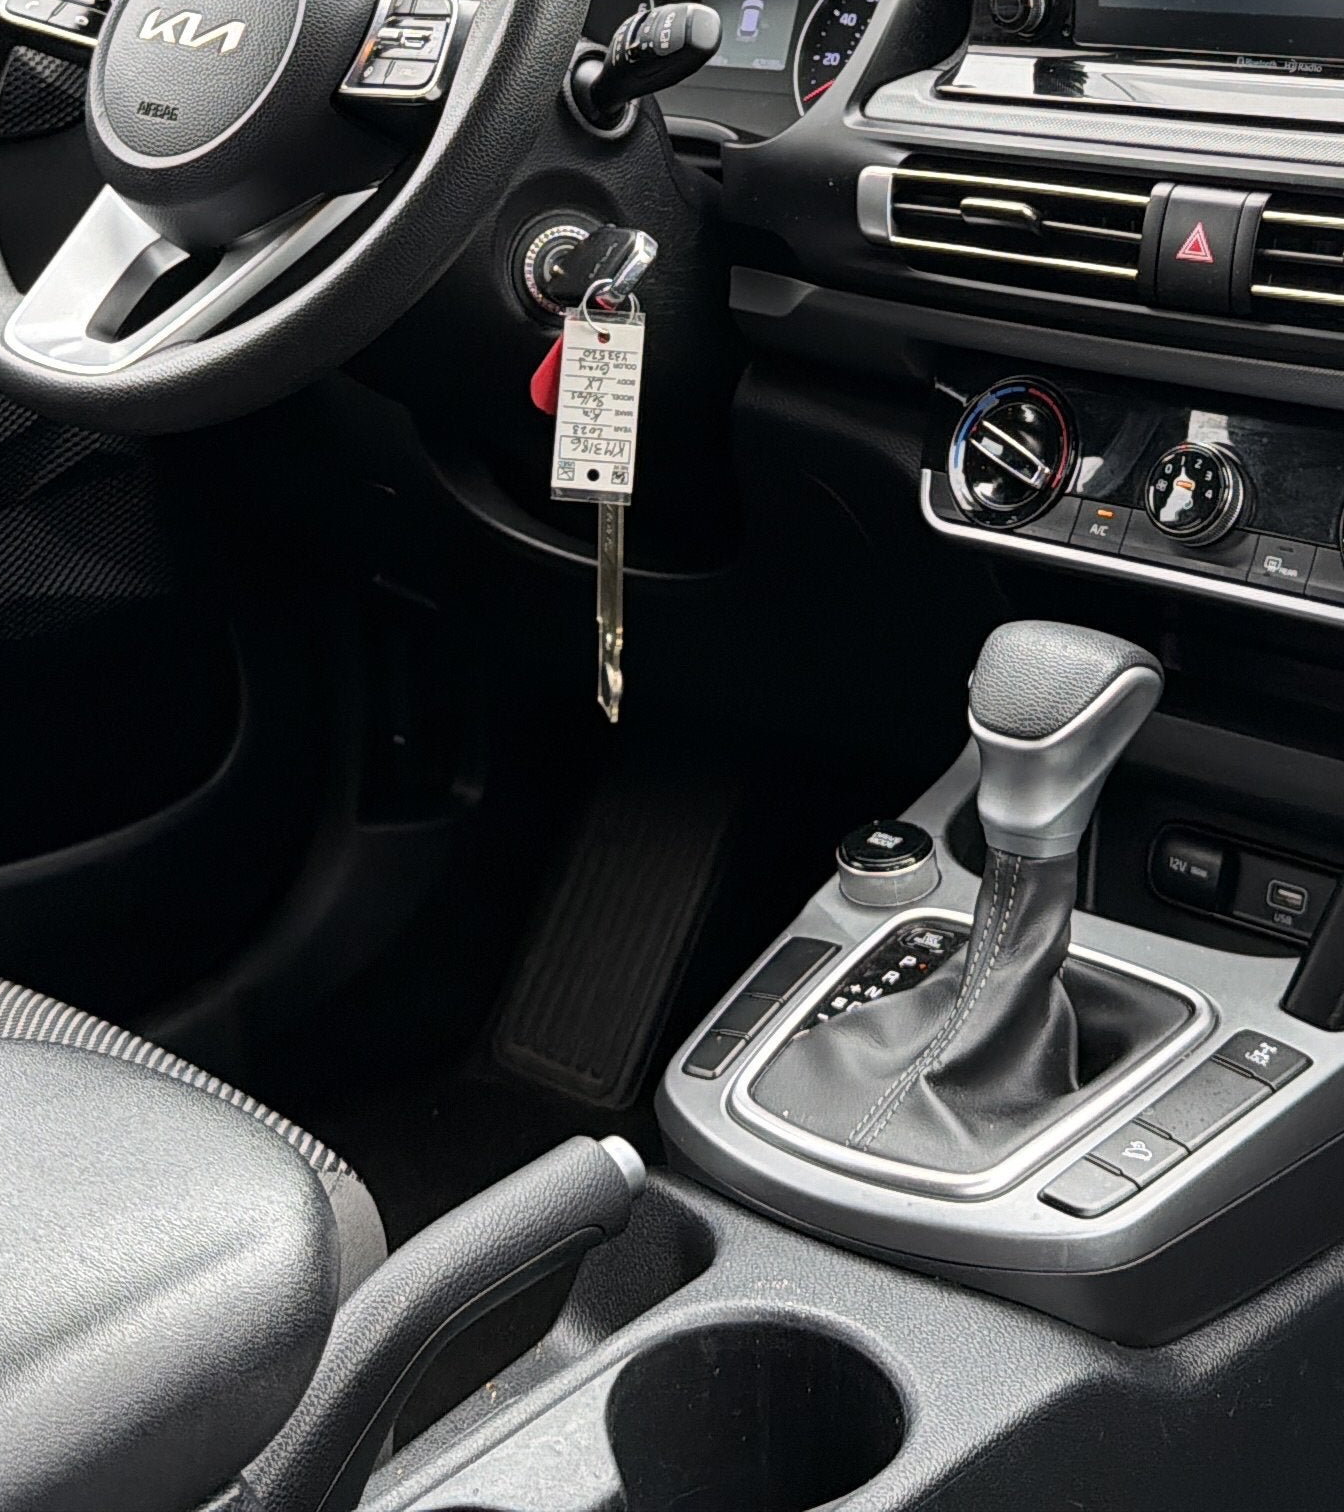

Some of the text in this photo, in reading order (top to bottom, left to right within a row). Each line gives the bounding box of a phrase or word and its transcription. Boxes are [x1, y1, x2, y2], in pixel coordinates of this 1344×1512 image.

[839, 12, 858, 27] 40
[139, 7, 247, 54] KIA
[822, 52, 841, 66] 20
[1297, 62, 1323, 73] Radio
[136, 100, 180, 122] AIRBAG
[584, 377, 604, 391] LX
[611, 393, 635, 402] MODEL
[614, 409, 634, 417] MAKE
[572, 424, 604, 438] 2023
[570, 437, 626, 458] KM3186
[1164, 463, 1173, 475] 0
[1194, 459, 1203, 469] 2
[1204, 470, 1213, 481] 3
[1204, 489, 1213, 499] 4
[1089, 523, 1109, 537] A/C
[1169, 856, 1188, 873] 12V
[1273, 911, 1293, 926] USB
[899, 955, 917, 968] P
[881, 970, 901, 986] R
[864, 985, 883, 1000] N
